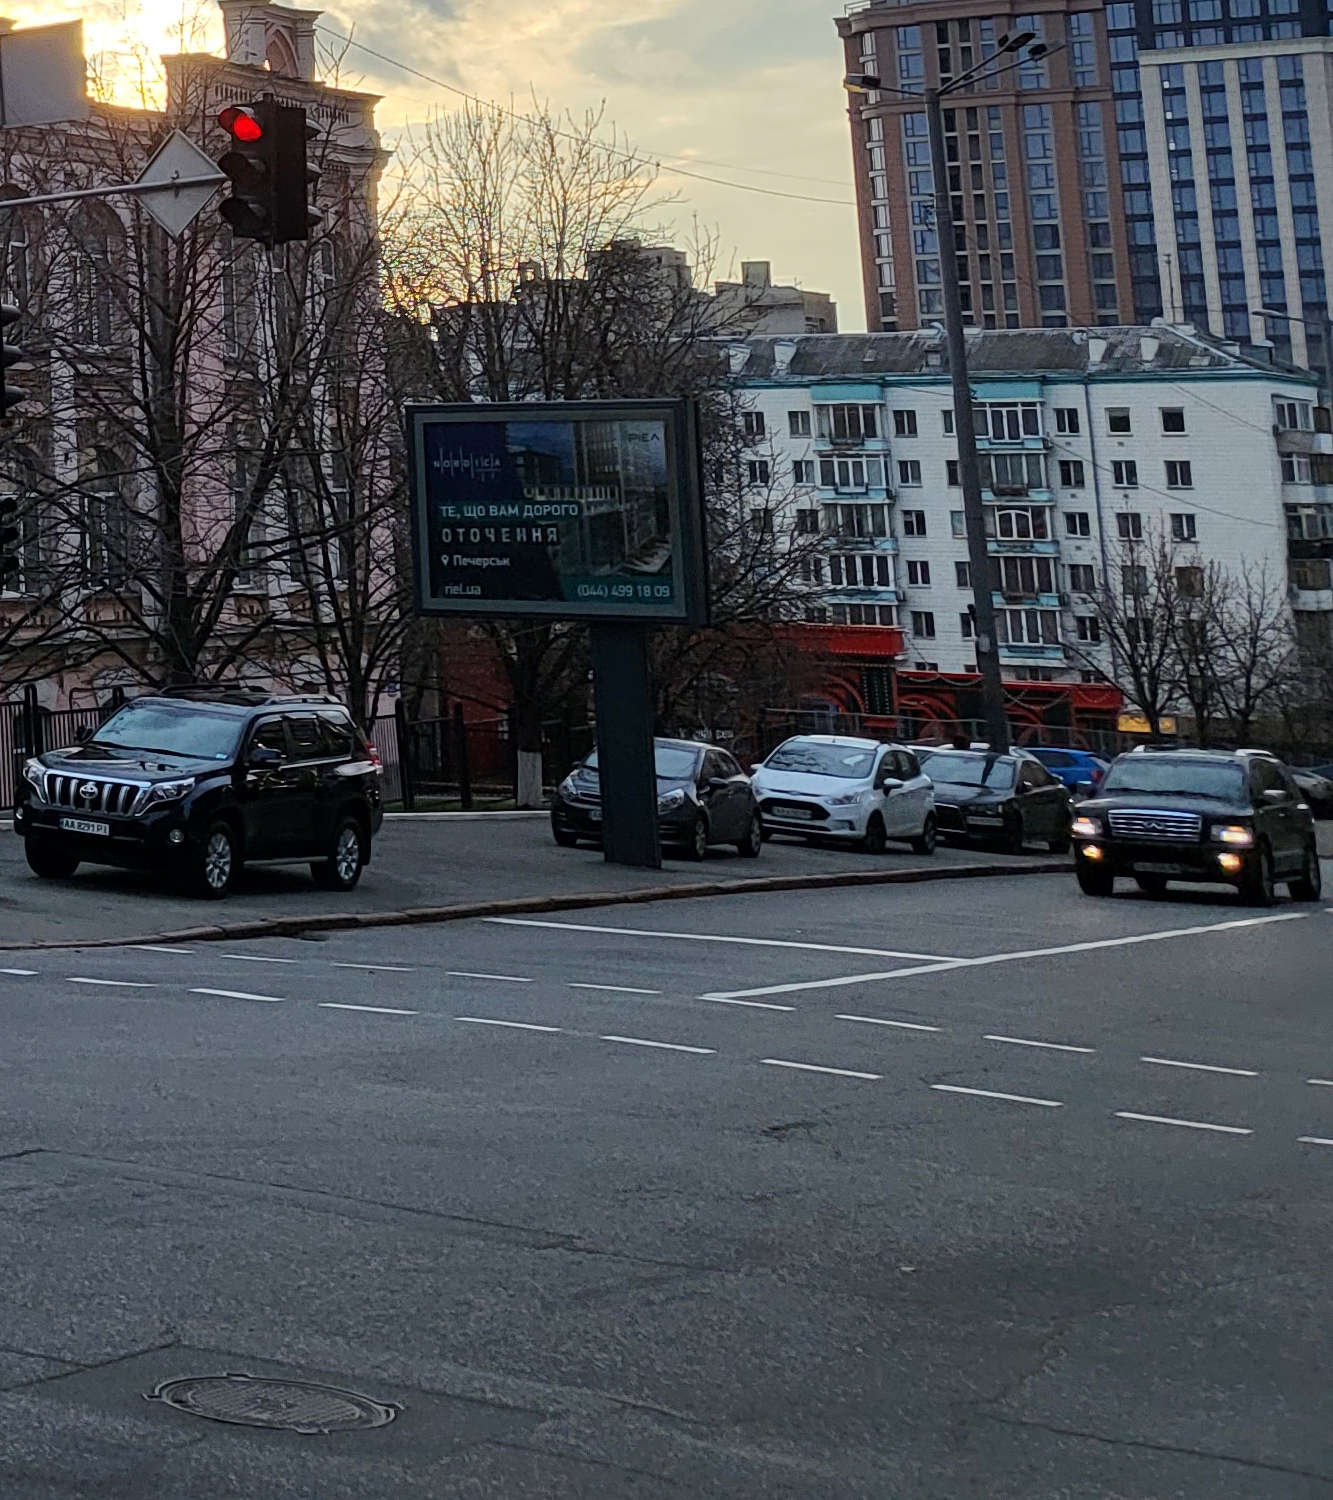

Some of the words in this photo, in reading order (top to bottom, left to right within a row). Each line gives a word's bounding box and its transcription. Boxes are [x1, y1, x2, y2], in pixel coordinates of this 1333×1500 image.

[440, 505, 461, 519] ТЕ,
[463, 504, 486, 519] ЩО
[488, 504, 519, 517] ВАМ
[522, 503, 579, 518] ДОРОГО
[441, 527, 558, 543] ОТОЧЕННЯ
[452, 554, 511, 569] Печерськ
[577, 584, 608, 598] (044)
[611, 584, 633, 597] 499
[636, 585, 652, 597] 18
[654, 585, 670, 597] 09
